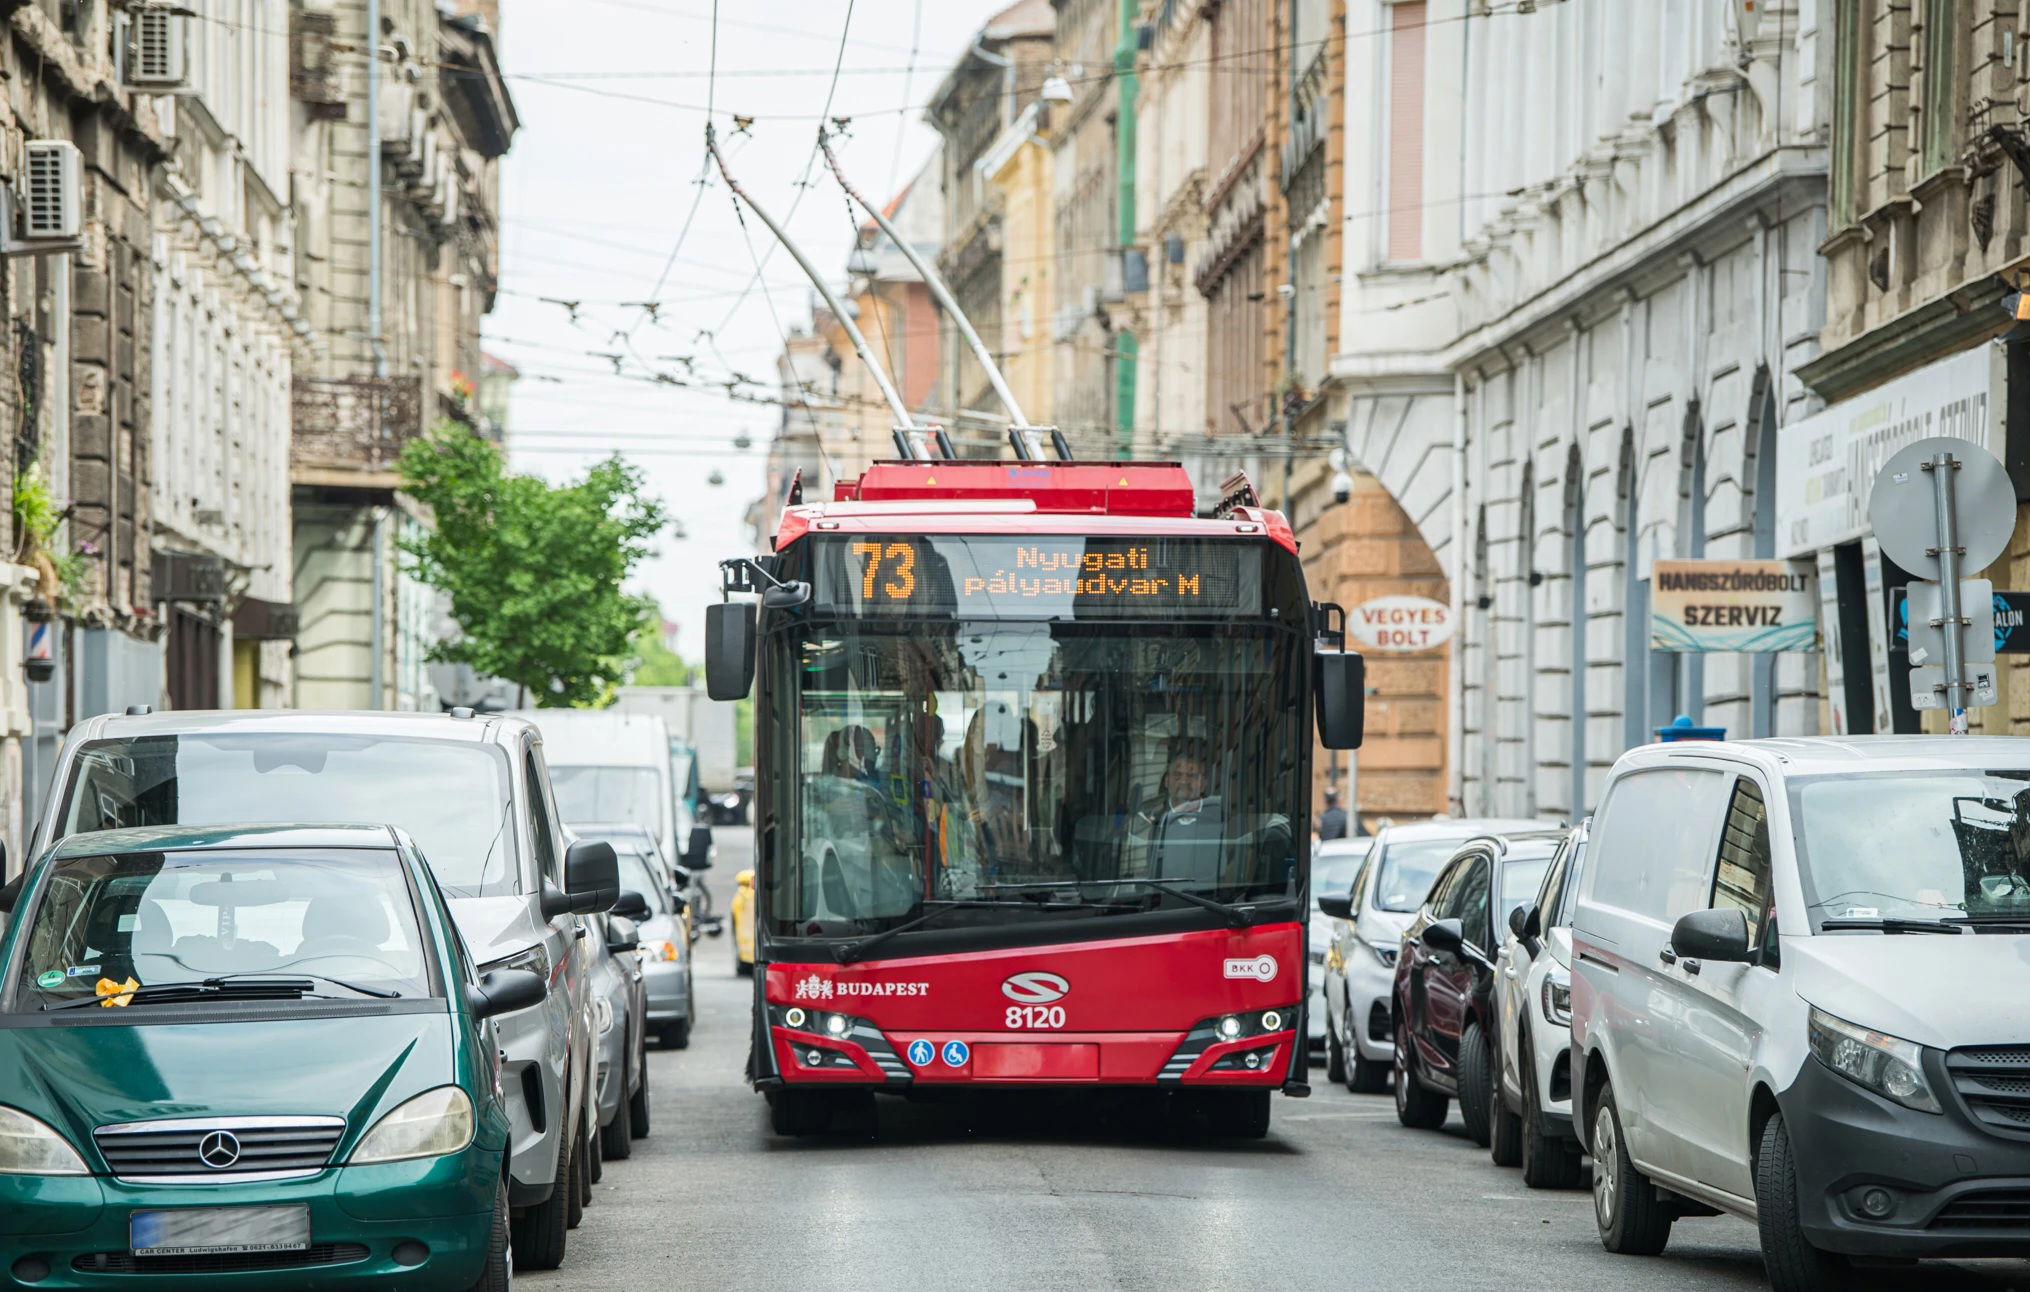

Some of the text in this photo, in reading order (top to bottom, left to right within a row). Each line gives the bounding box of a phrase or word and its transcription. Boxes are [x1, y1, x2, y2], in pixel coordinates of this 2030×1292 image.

[1016, 546, 1149, 571] Nyugati
[852, 542, 916, 599] 73
[1659, 568, 1809, 592] HANGSZÓRÓBOLT
[964, 569, 1200, 597] pályaudvar M
[1362, 607, 1447, 625] VEGYES
[1684, 604, 1783, 627] SZERVIZ
[1994, 609, 2024, 628] ALON
[1377, 629, 1430, 647] BOLT
[1231, 964, 1254, 973] BKK
[836, 982, 930, 996] BUDAPEST
[1004, 1006, 1066, 1029] 8120
